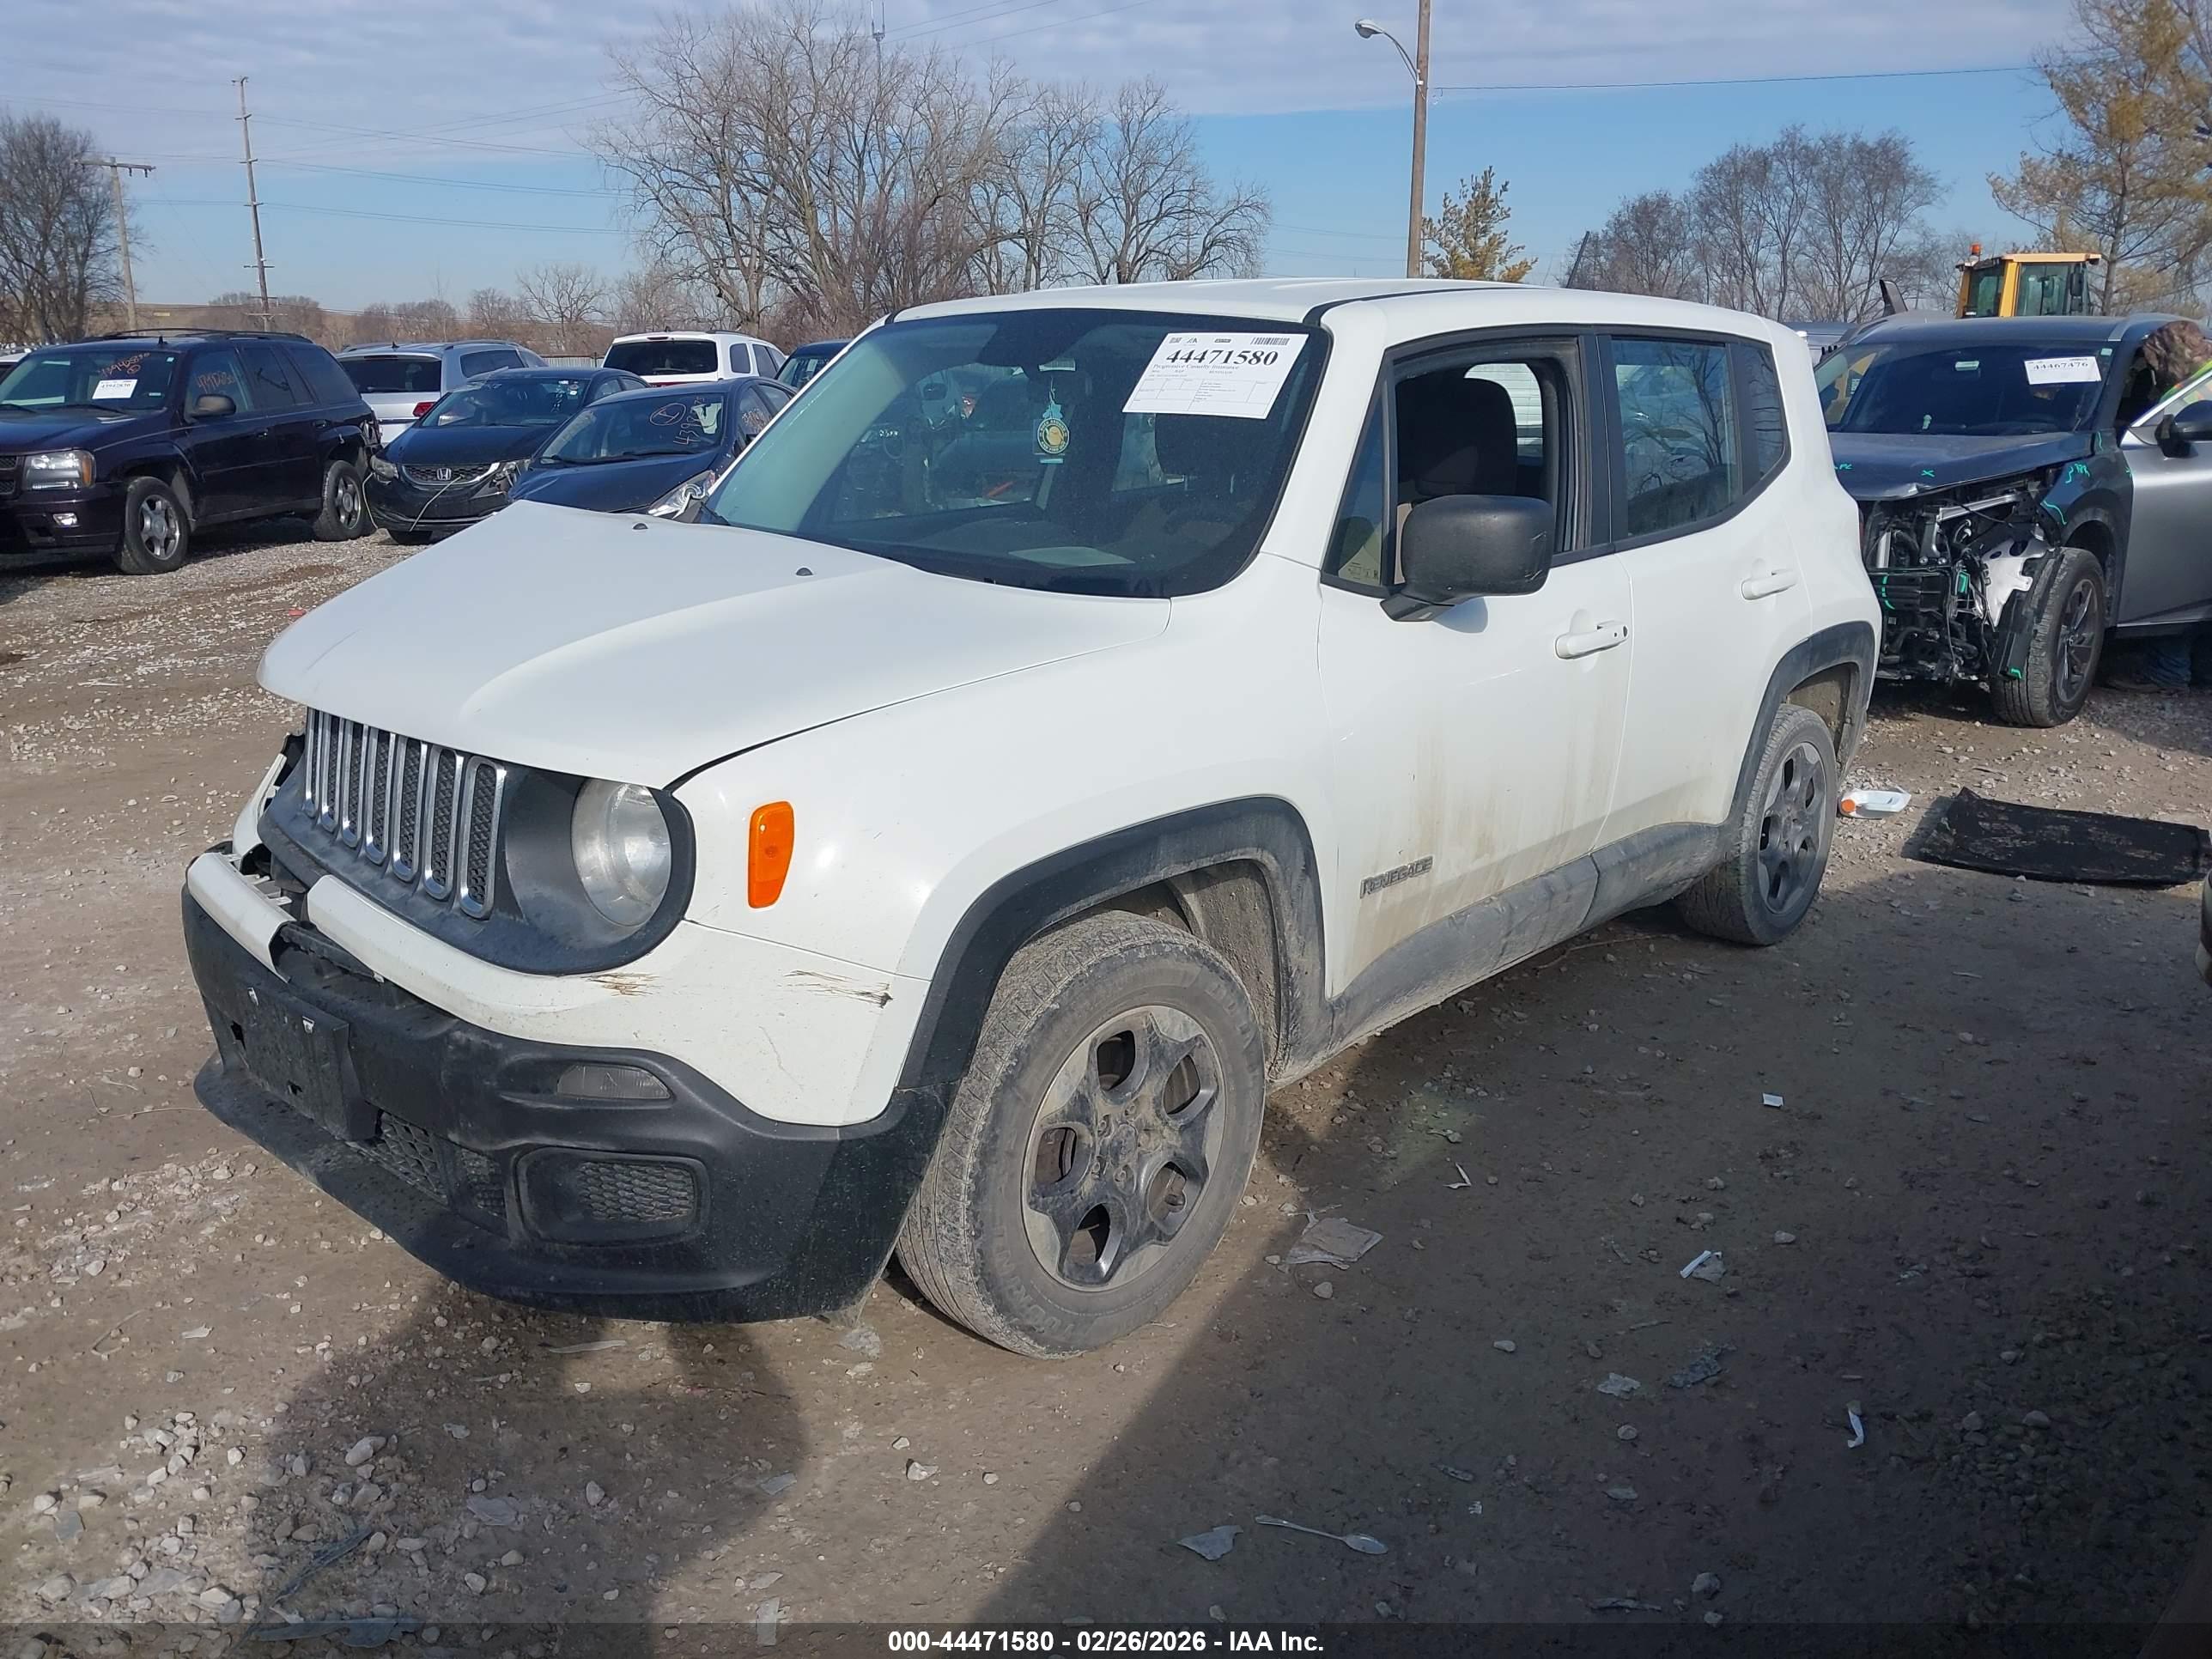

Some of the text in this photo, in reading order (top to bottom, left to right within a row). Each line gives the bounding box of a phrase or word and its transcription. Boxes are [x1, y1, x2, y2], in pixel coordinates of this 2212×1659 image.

[1166, 349, 1279, 366] 44471580
[2033, 362, 2088, 370] 44467476
[1359, 855, 1433, 899] RENEGADE
